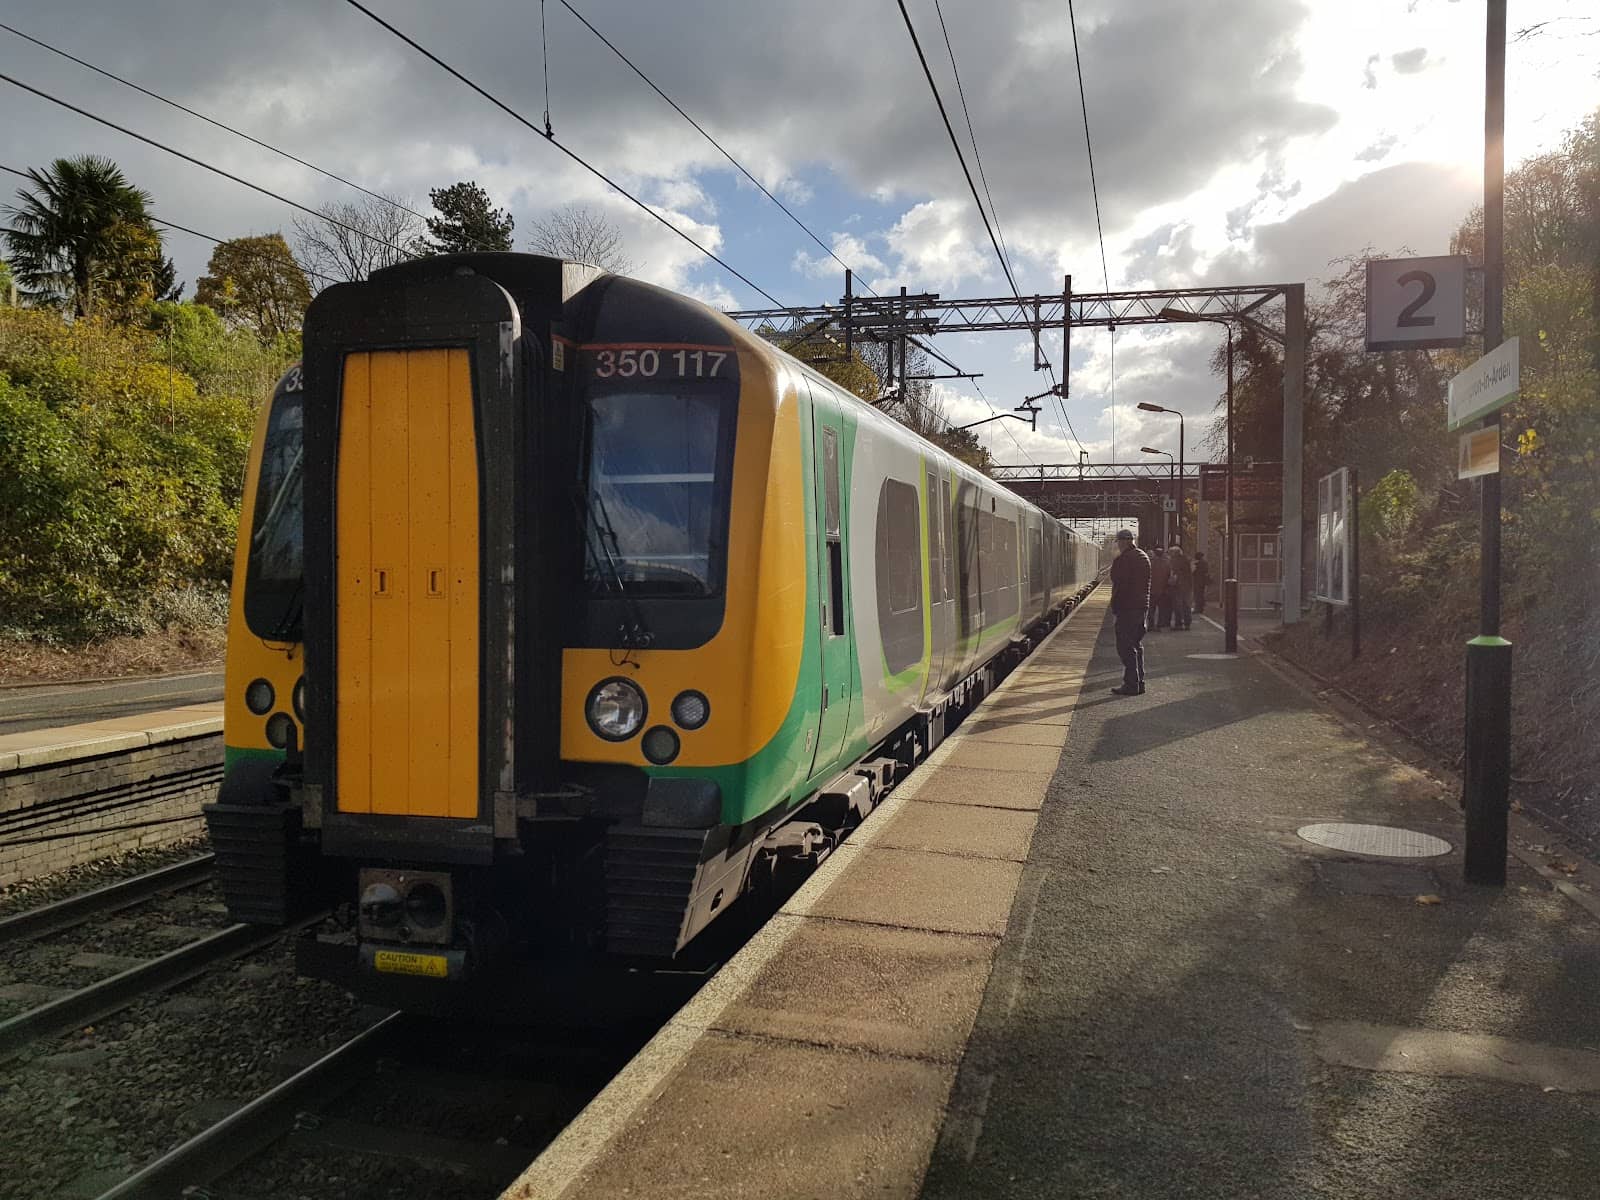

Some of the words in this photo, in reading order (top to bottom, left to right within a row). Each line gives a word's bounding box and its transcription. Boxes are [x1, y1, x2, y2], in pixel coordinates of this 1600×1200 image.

[1396, 270, 1436, 328] 2
[596, 350, 660, 377] 350
[672, 350, 728, 377] 117
[380, 953, 417, 963] CAUTION
